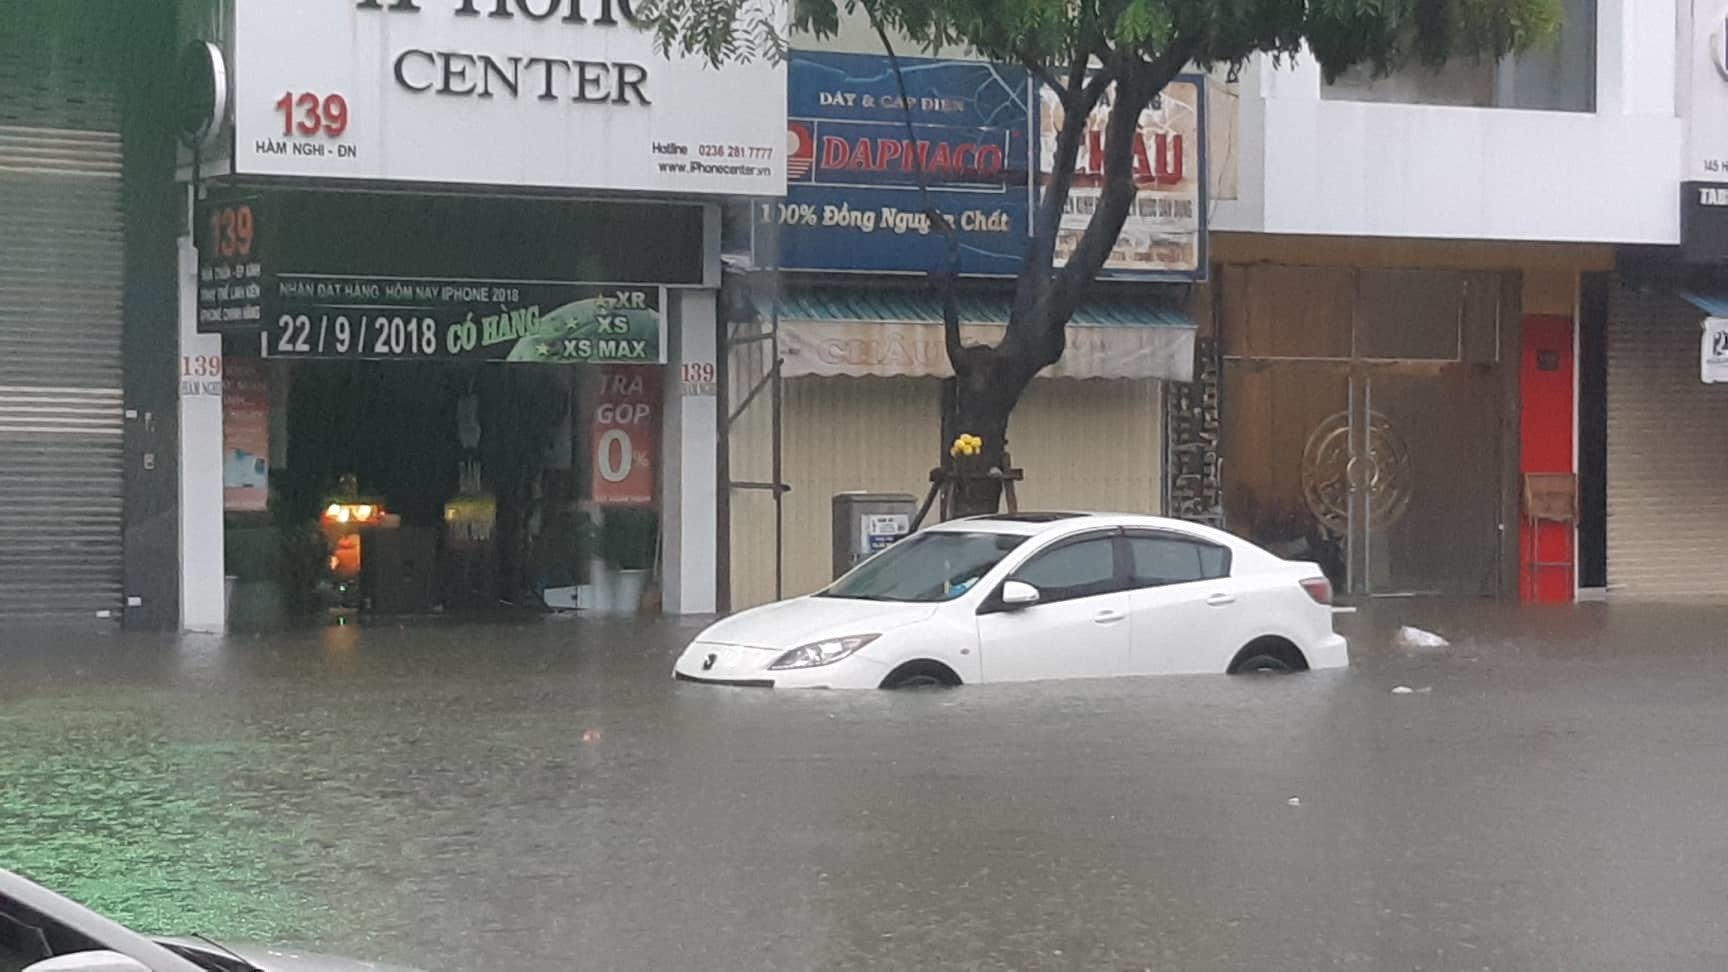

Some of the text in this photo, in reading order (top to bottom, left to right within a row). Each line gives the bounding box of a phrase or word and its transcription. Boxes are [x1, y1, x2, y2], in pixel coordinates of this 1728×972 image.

[393, 48, 652, 107] CENTER
[276, 91, 349, 137] 139
[256, 137, 288, 155] HÀM
[292, 143, 325, 156] NGHI
[336, 144, 358, 158] ĐN
[651, 140, 689, 155] Hotline
[821, 135, 1004, 175] DAPNACO
[210, 205, 254, 257] 139
[879, 207, 956, 234] Nguyn
[960, 209, 1010, 232] Chất
[415, 285, 439, 299] NAY
[441, 286, 489, 302] IPHONE
[492, 288, 520, 302] 2018
[615, 290, 646, 309] XR
[447, 311, 477, 354] CÓ
[481, 305, 541, 346] HÀNG
[596, 315, 628, 334] XS
[563, 339, 647, 359] XS MAX
[182, 355, 222, 377] 139
[681, 362, 714, 383] 139
